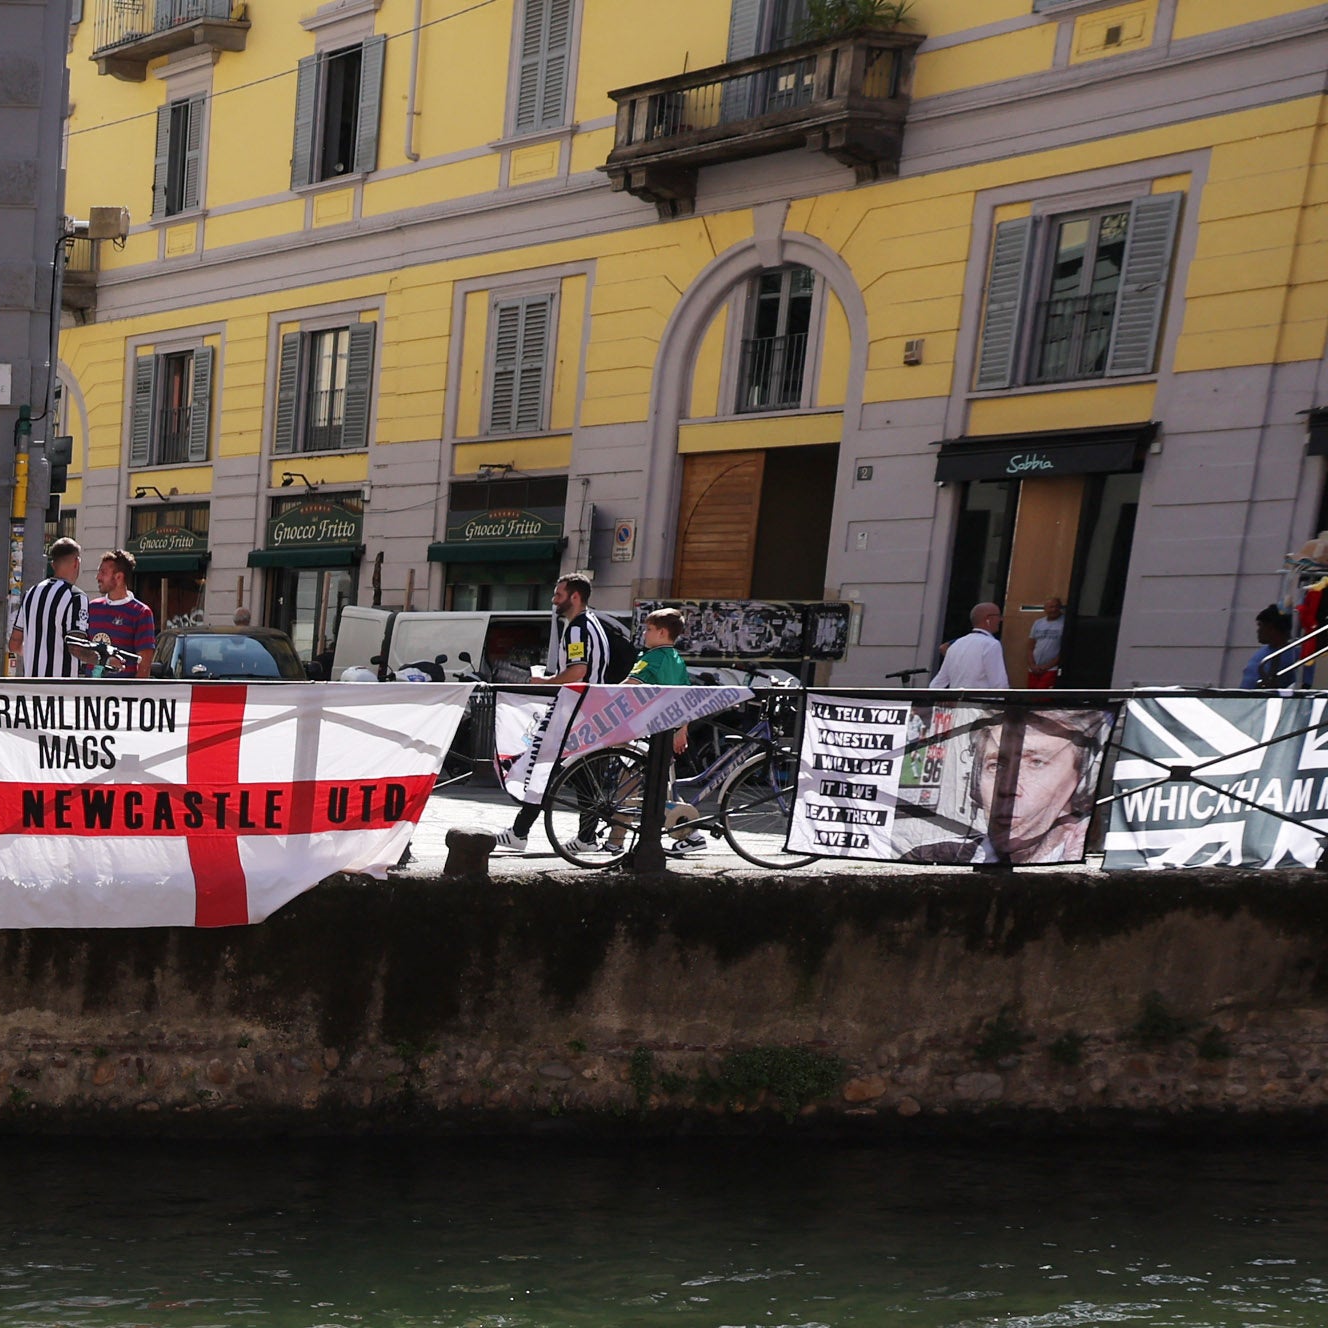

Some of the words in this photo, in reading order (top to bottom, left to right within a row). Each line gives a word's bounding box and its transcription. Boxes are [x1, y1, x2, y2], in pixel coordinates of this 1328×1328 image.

[860, 467, 868, 479] 2
[1006, 454, 1054, 474] Sabbia
[274, 522, 316, 546] Gnocco
[317, 518, 355, 541] Fritto
[465, 521, 504, 541] Gnocco
[506, 519, 541, 537] Fritto
[139, 536, 167, 552] Gnocco
[168, 534, 194, 551] Fritto
[835, 707, 865, 722] TELL
[870, 709, 901, 724] YOU.
[818, 729, 889, 750] HONESTLY.
[38, 735, 117, 770] MAGS
[821, 756, 851, 772] WILL
[854, 759, 889, 775] LOVE
[922, 759, 943, 784] 96
[820, 781, 835, 796] IT
[839, 783, 848, 796] IF
[852, 785, 873, 799] WE
[1122, 777, 1314, 823] WHICKHAM
[22, 788, 283, 831] NEWCASTLE
[327, 783, 408, 825] UTD
[845, 808, 881, 825] THEM.
[815, 831, 847, 846] LOVE
[851, 833, 868, 848] IT.
